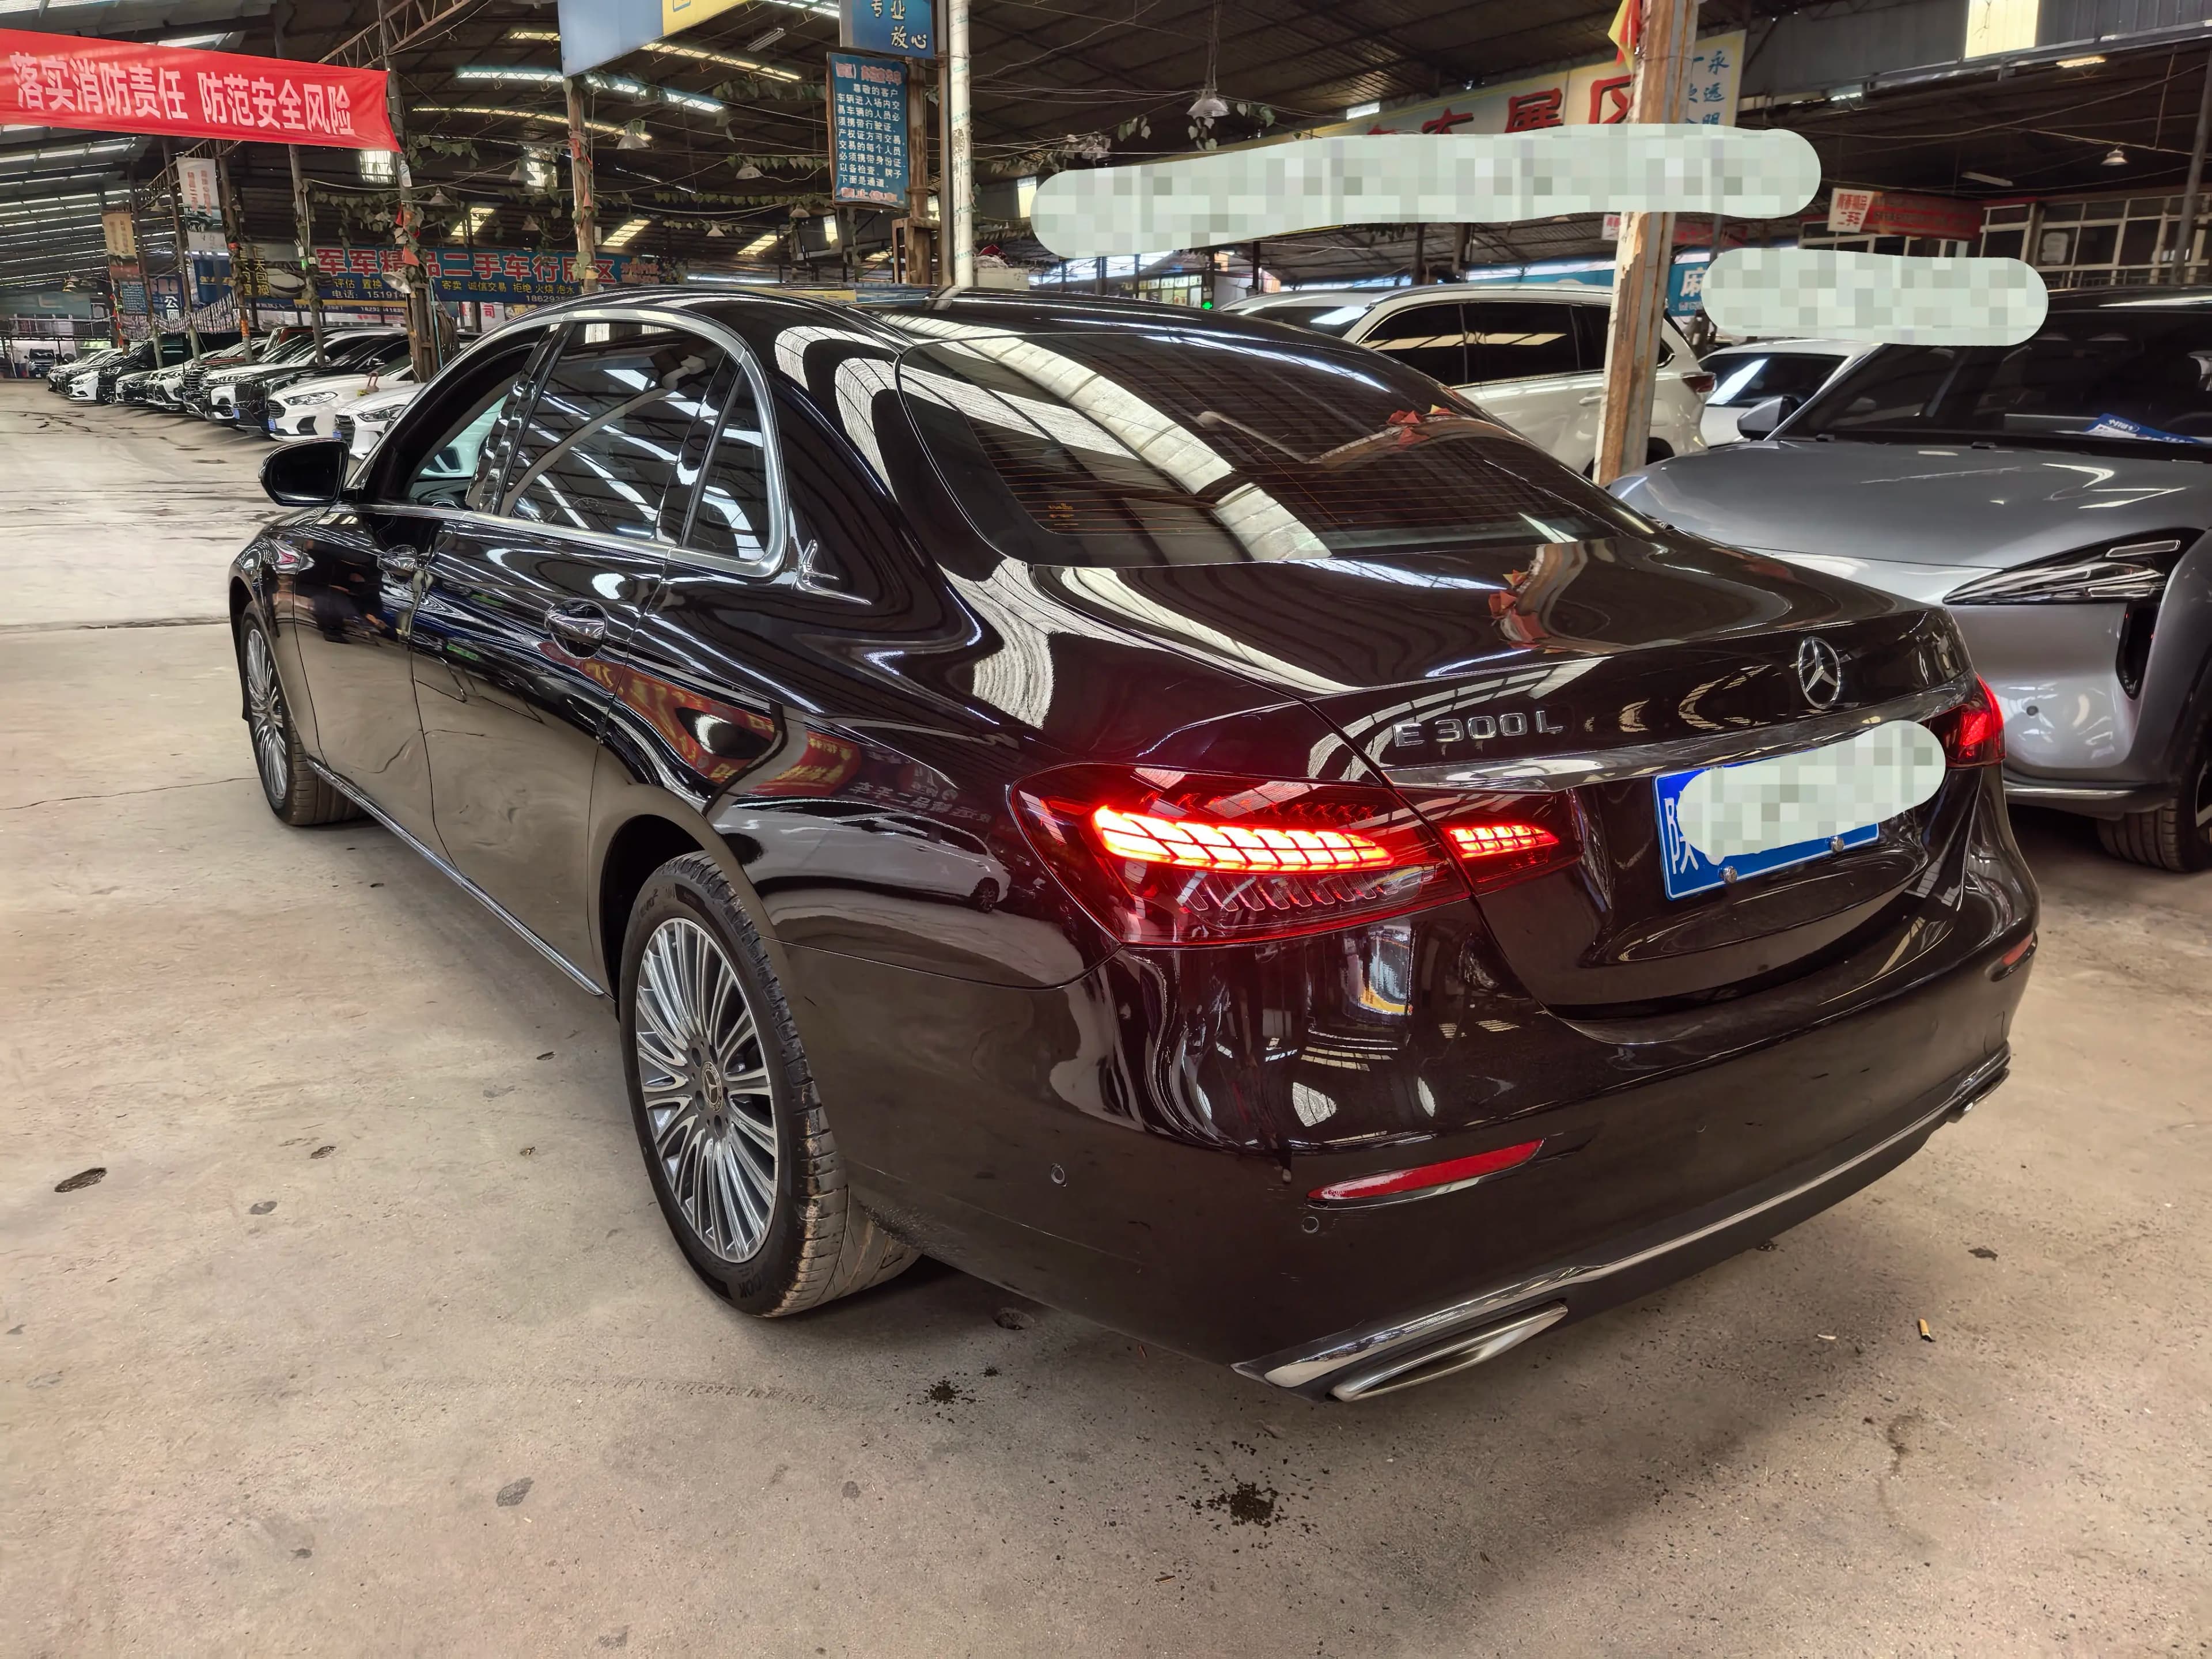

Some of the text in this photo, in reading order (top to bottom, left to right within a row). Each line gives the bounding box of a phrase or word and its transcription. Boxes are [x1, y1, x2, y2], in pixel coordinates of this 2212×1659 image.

[891, 25, 927, 50] 放心
[9, 51, 355, 136] 落实消防责任 防范安全风险
[334, 278, 356, 289] 评估
[468, 281, 507, 292] 诚信交易
[1392, 710, 1566, 747] E 300 L
